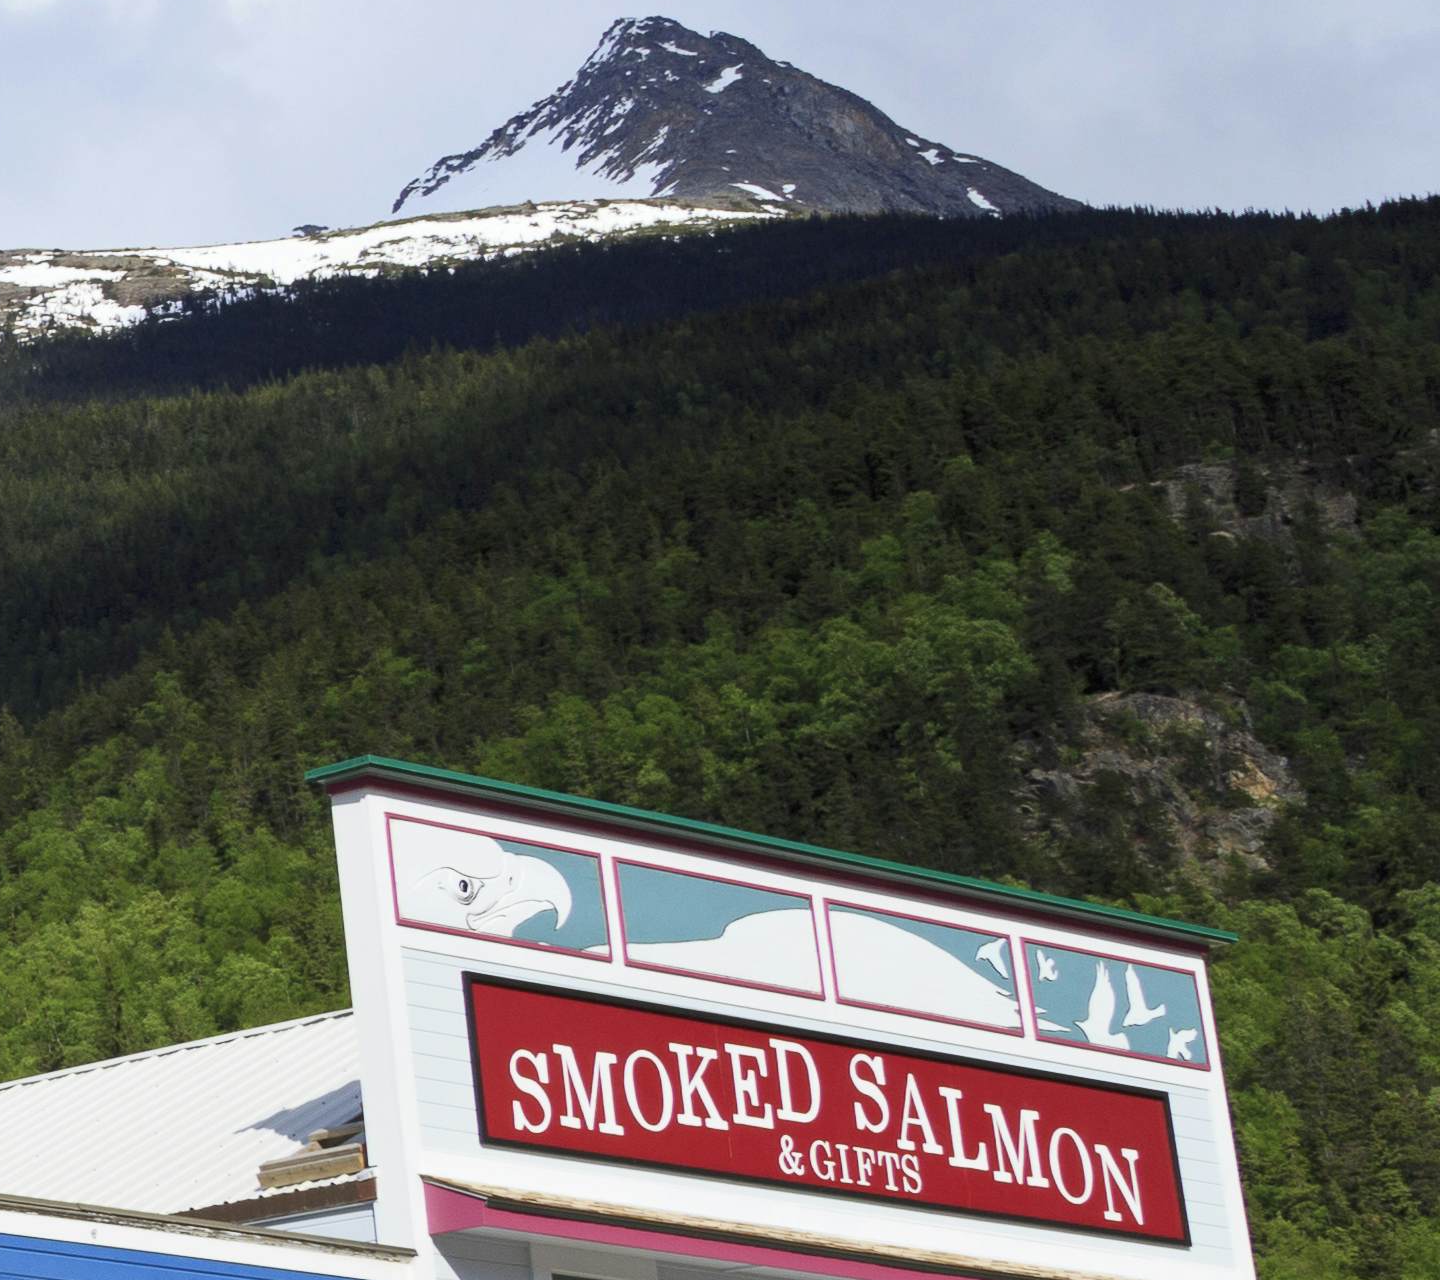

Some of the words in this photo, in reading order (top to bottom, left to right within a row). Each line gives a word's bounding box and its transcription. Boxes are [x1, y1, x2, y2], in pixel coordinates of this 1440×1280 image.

[508, 1037, 822, 1135] SMOKED
[847, 1052, 1144, 1226] SALMON
[809, 1139, 923, 1194] GIFTS
